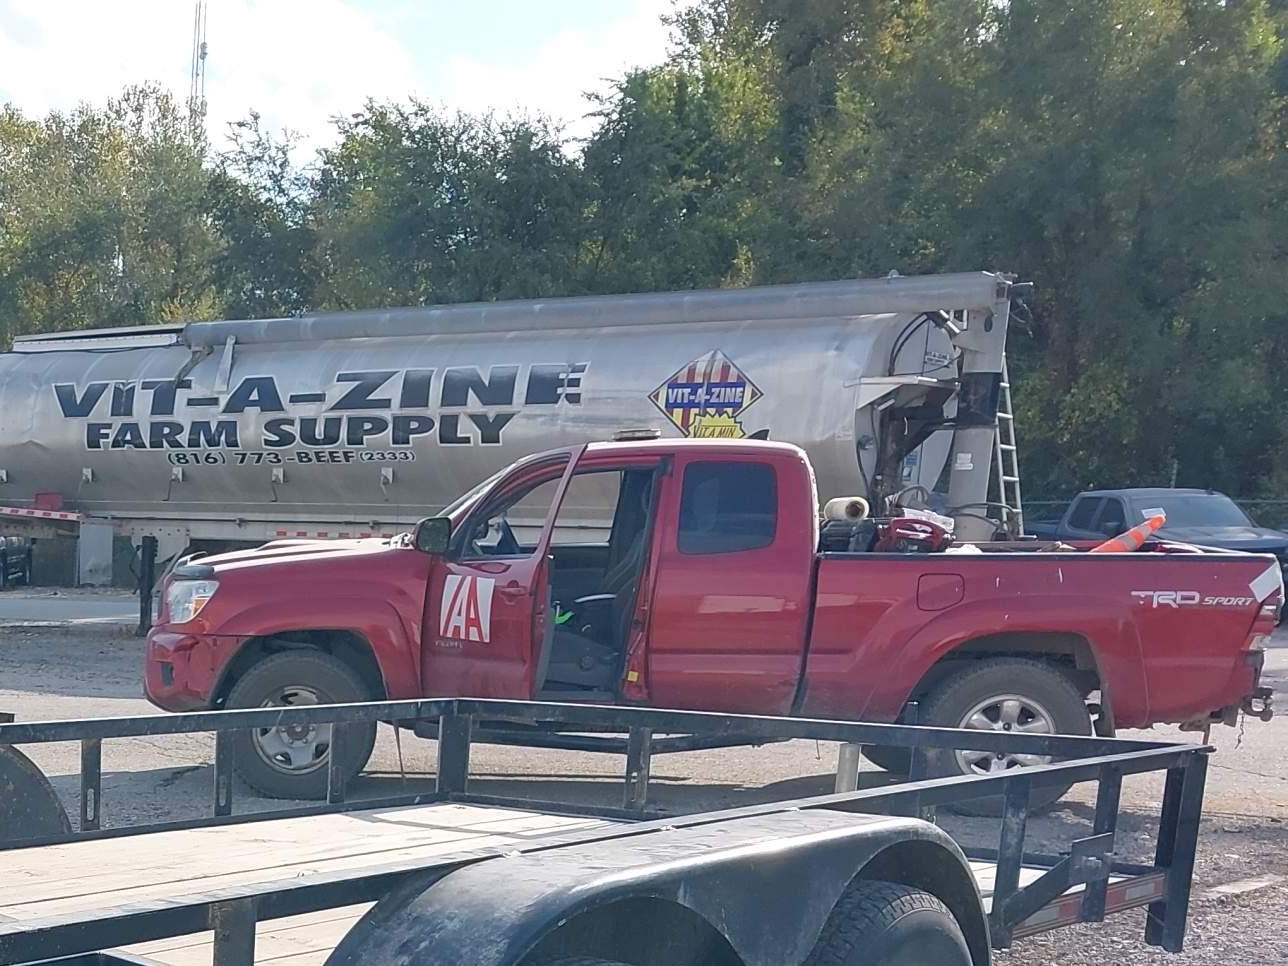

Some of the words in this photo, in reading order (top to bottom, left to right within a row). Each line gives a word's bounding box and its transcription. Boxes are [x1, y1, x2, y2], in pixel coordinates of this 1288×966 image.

[52, 361, 590, 417] VIT-A-ZINE
[668, 387, 744, 403] VIT-A-ZINE
[86, 419, 240, 449] FARM
[263, 411, 520, 447] SUPPLY
[168, 452, 226, 465] (816)
[360, 451, 416, 462] (2333)
[1130, 591, 1200, 608] TRD
[1202, 596, 1253, 606] SPORT
